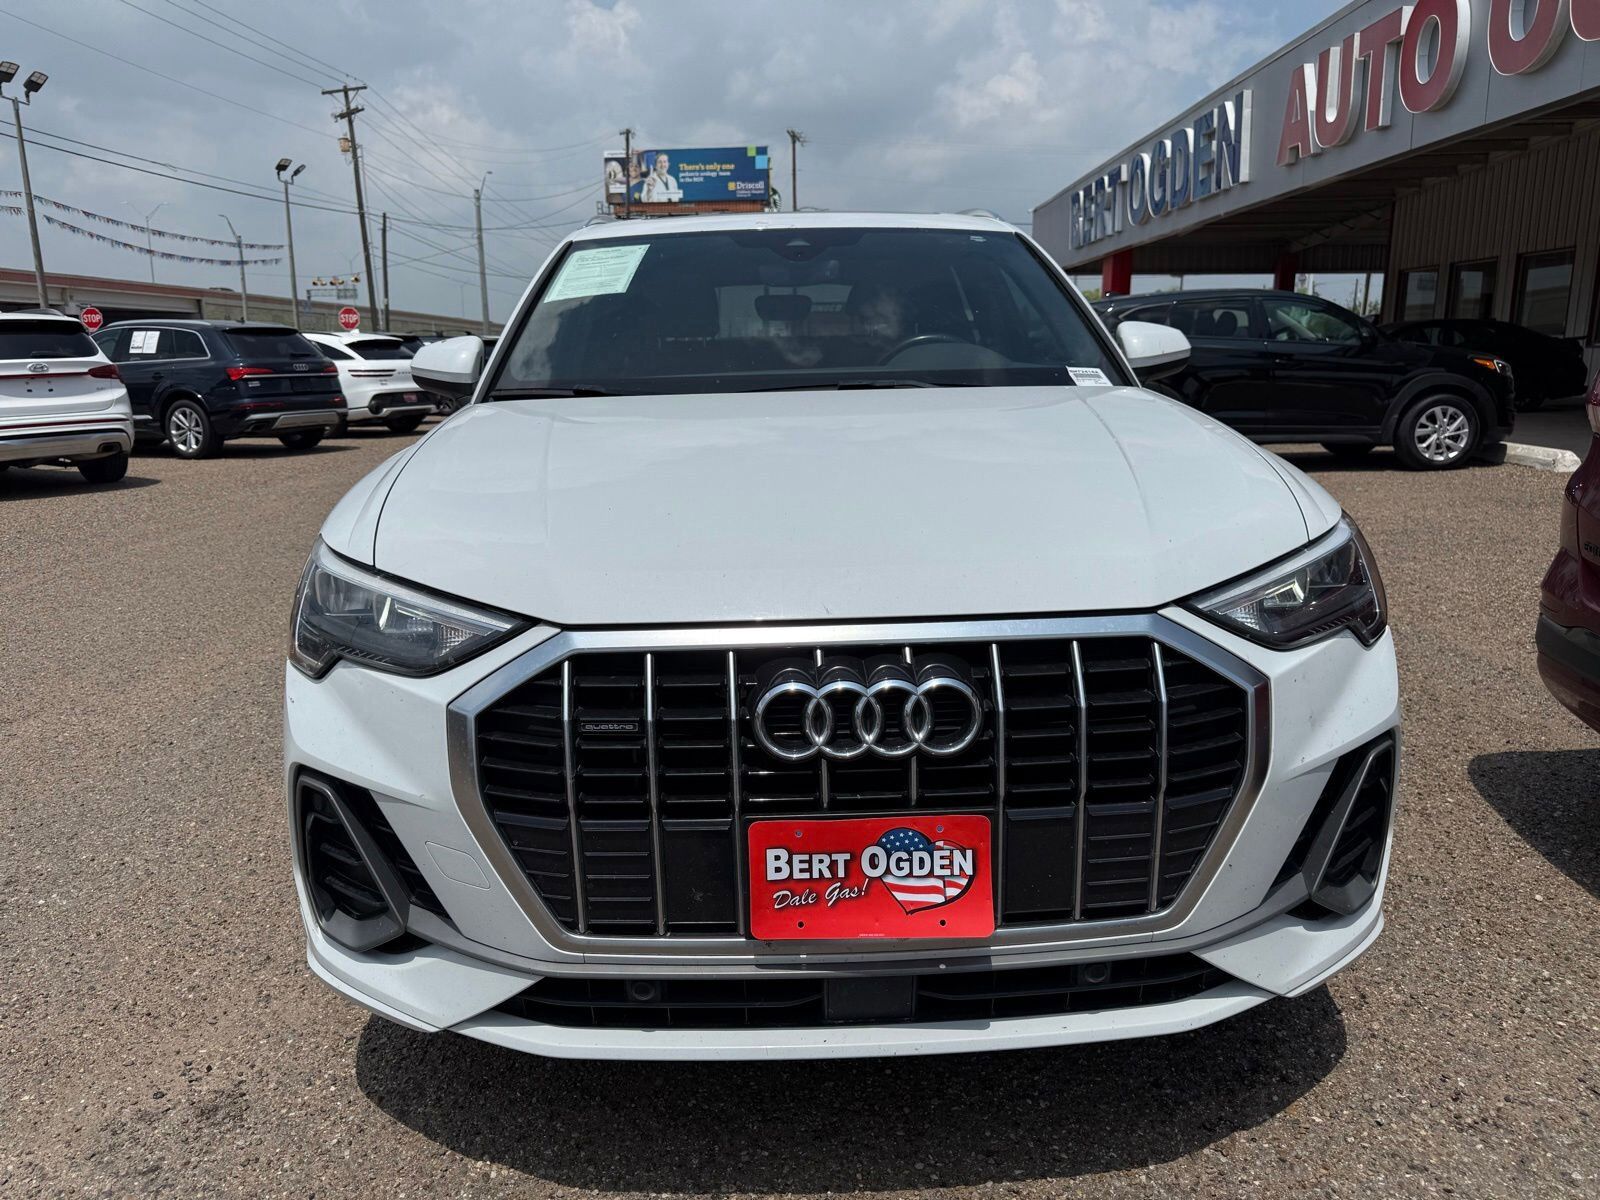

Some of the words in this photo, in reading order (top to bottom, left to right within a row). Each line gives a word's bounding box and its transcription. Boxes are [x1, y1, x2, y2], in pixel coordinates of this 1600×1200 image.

[1069, 164, 1128, 249] BERT
[1127, 89, 1252, 226] OGDEN
[1276, 0, 1471, 167] AUTO
[705, 162, 721, 171] only
[736, 181, 765, 190] Driscoll
[83, 314, 101, 323] STOP
[340, 314, 359, 323] STOP
[766, 848, 851, 881] BERT
[860, 845, 974, 878] OGDEN
[772, 889, 817, 909] Dale
[825, 878, 869, 907] Gas!
